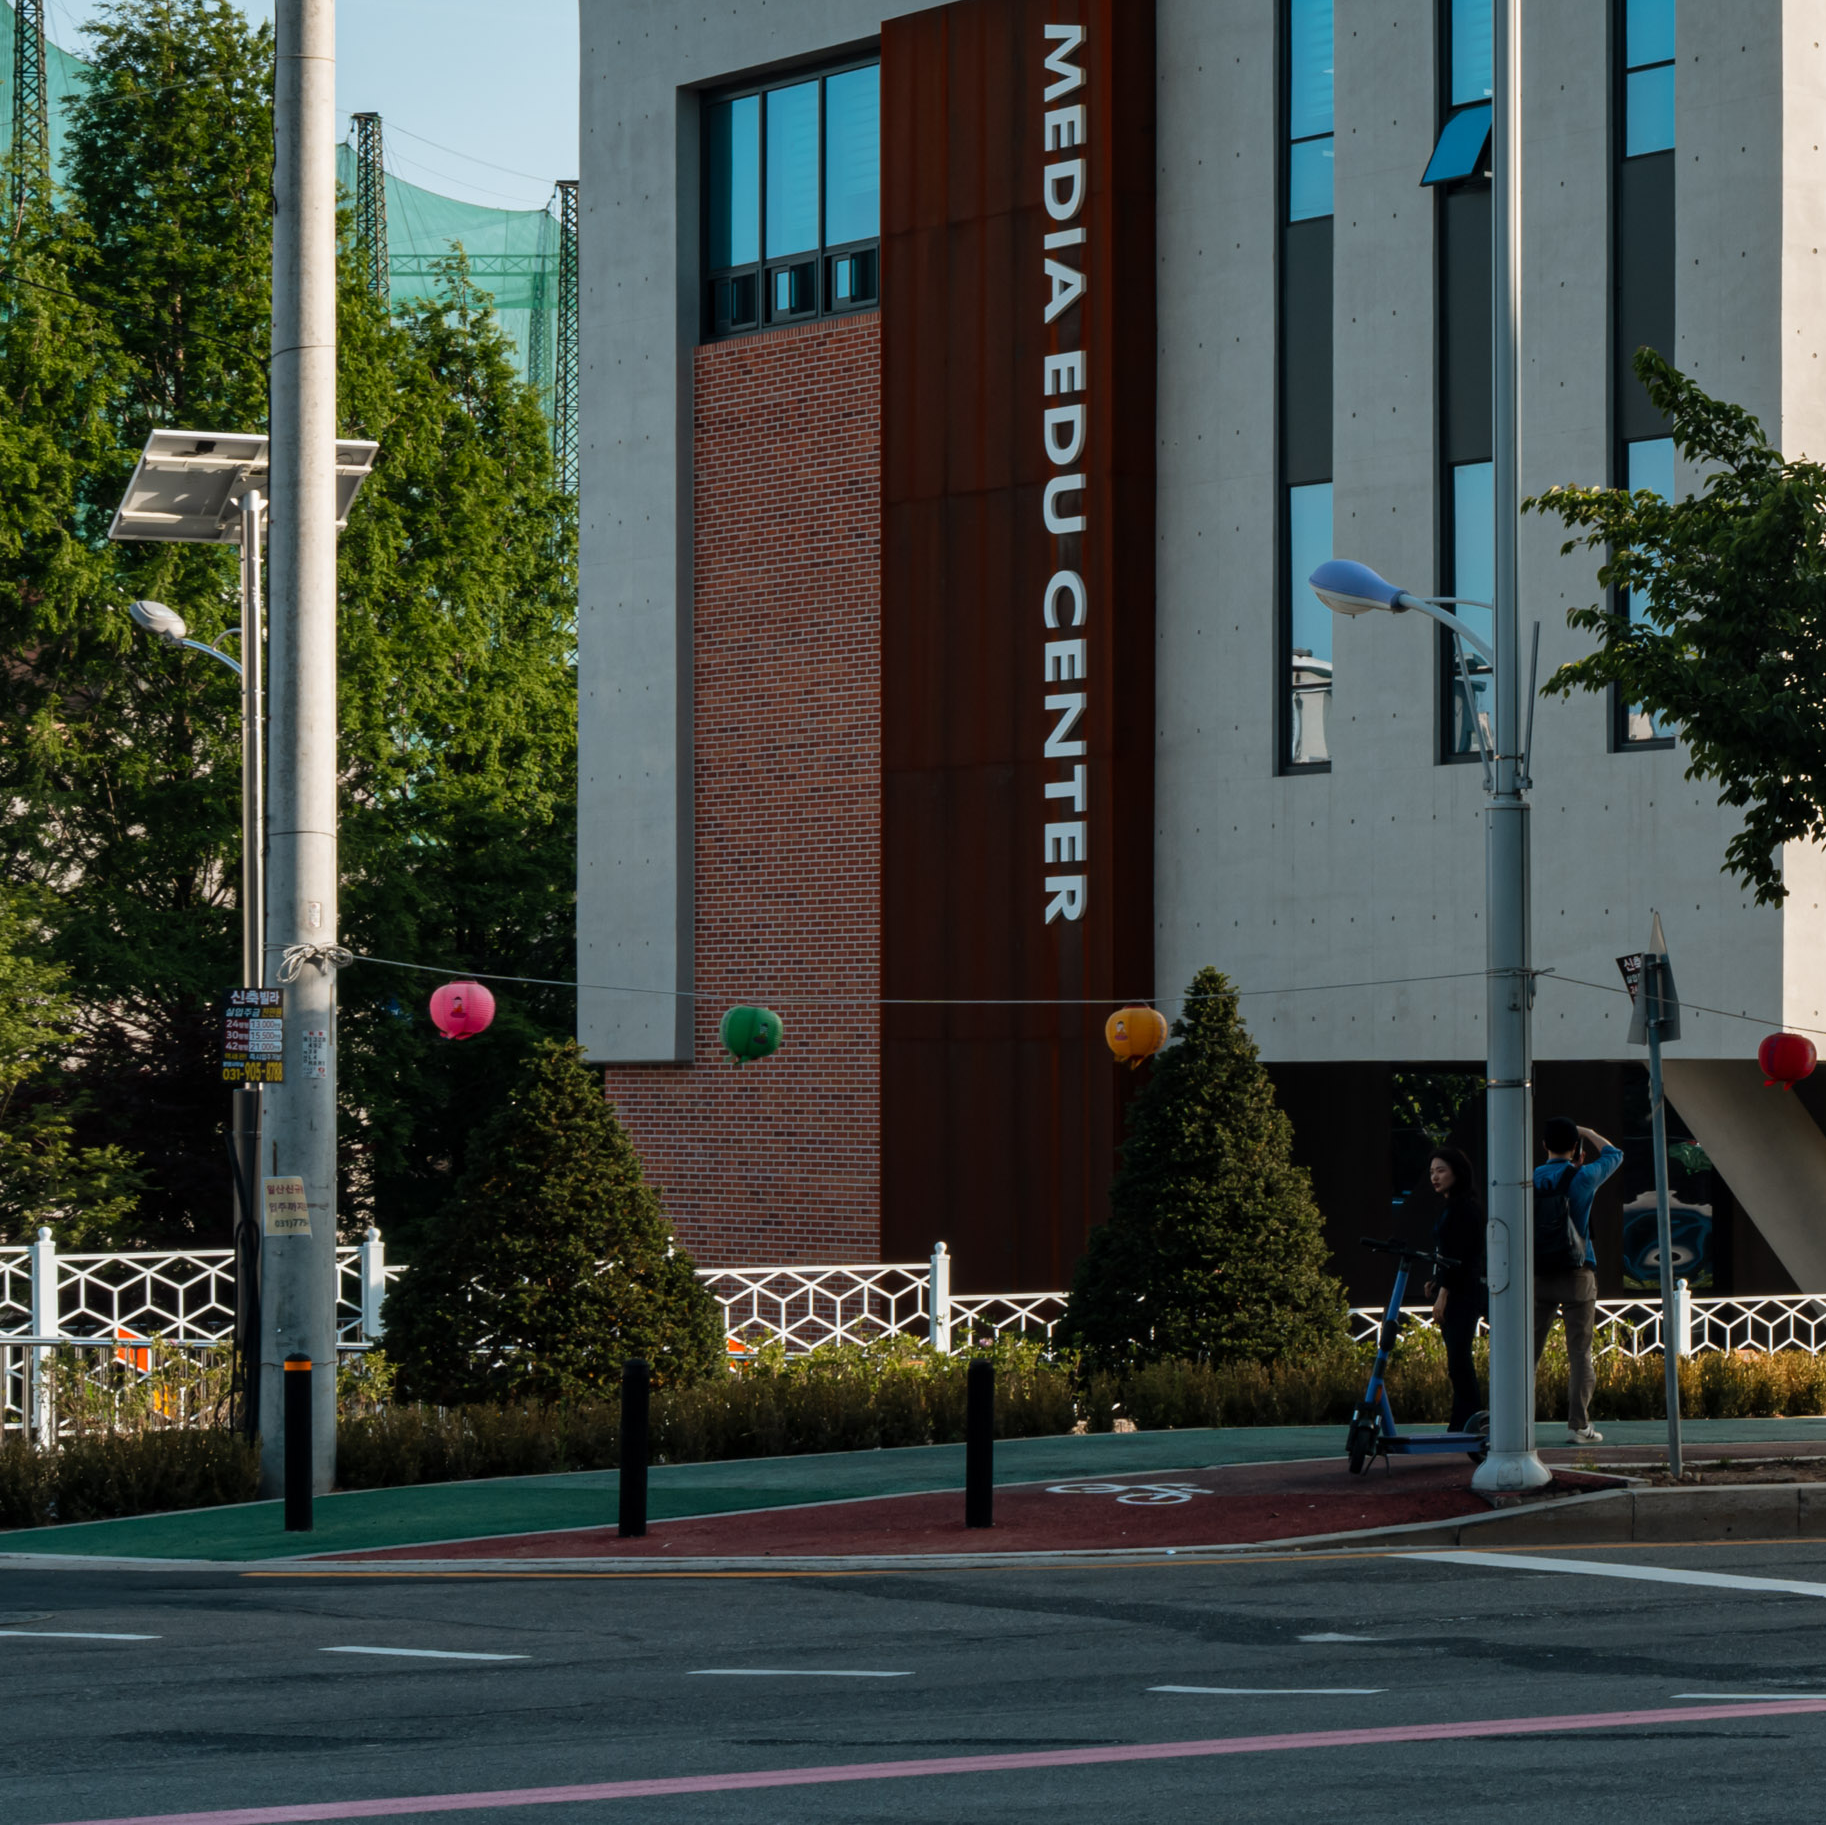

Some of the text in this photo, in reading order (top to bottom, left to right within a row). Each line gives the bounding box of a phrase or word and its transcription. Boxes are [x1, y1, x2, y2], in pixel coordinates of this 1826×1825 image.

[1043, 23, 1087, 925] MEDIA EDU CENTER
[230, 990, 280, 1005] 신축빌라
